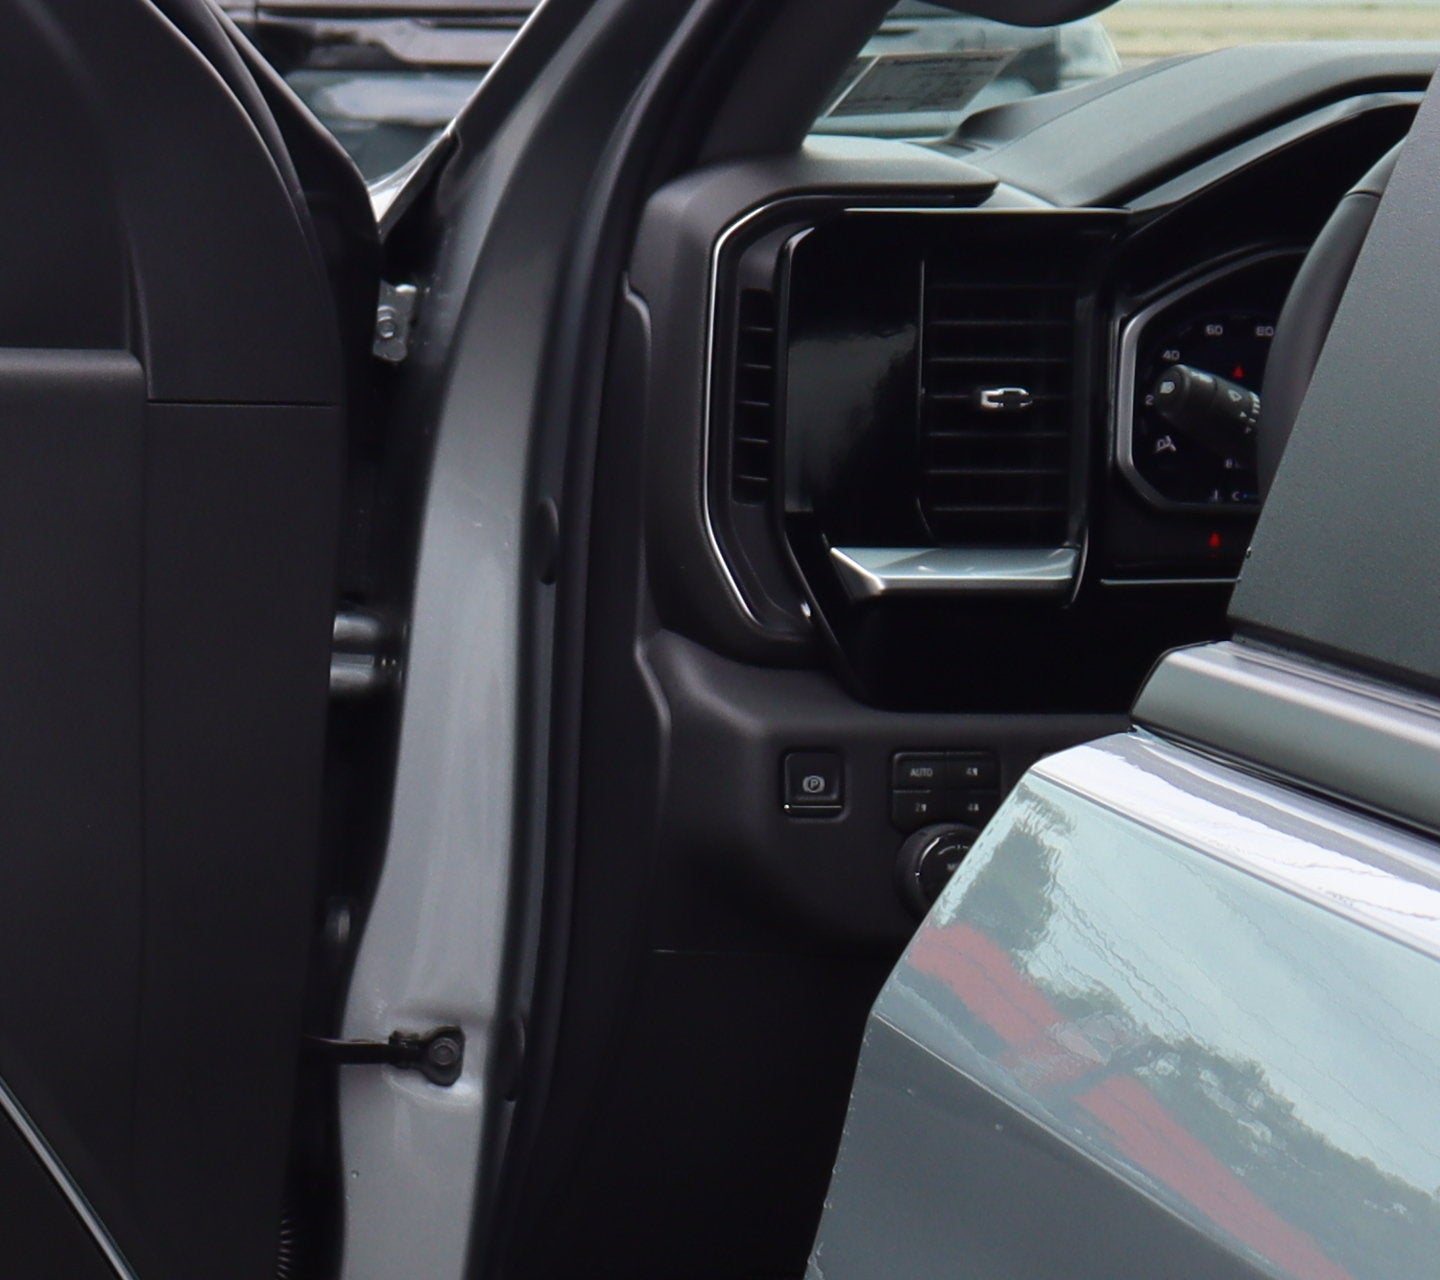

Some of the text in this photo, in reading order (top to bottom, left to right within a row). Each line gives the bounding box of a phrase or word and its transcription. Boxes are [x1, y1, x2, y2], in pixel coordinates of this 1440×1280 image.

[1205, 324, 1224, 336] 60
[1255, 326, 1275, 337] 80
[1162, 349, 1180, 361] 40
[1145, 394, 1155, 405] 2
[910, 768, 933, 778] AUTO
